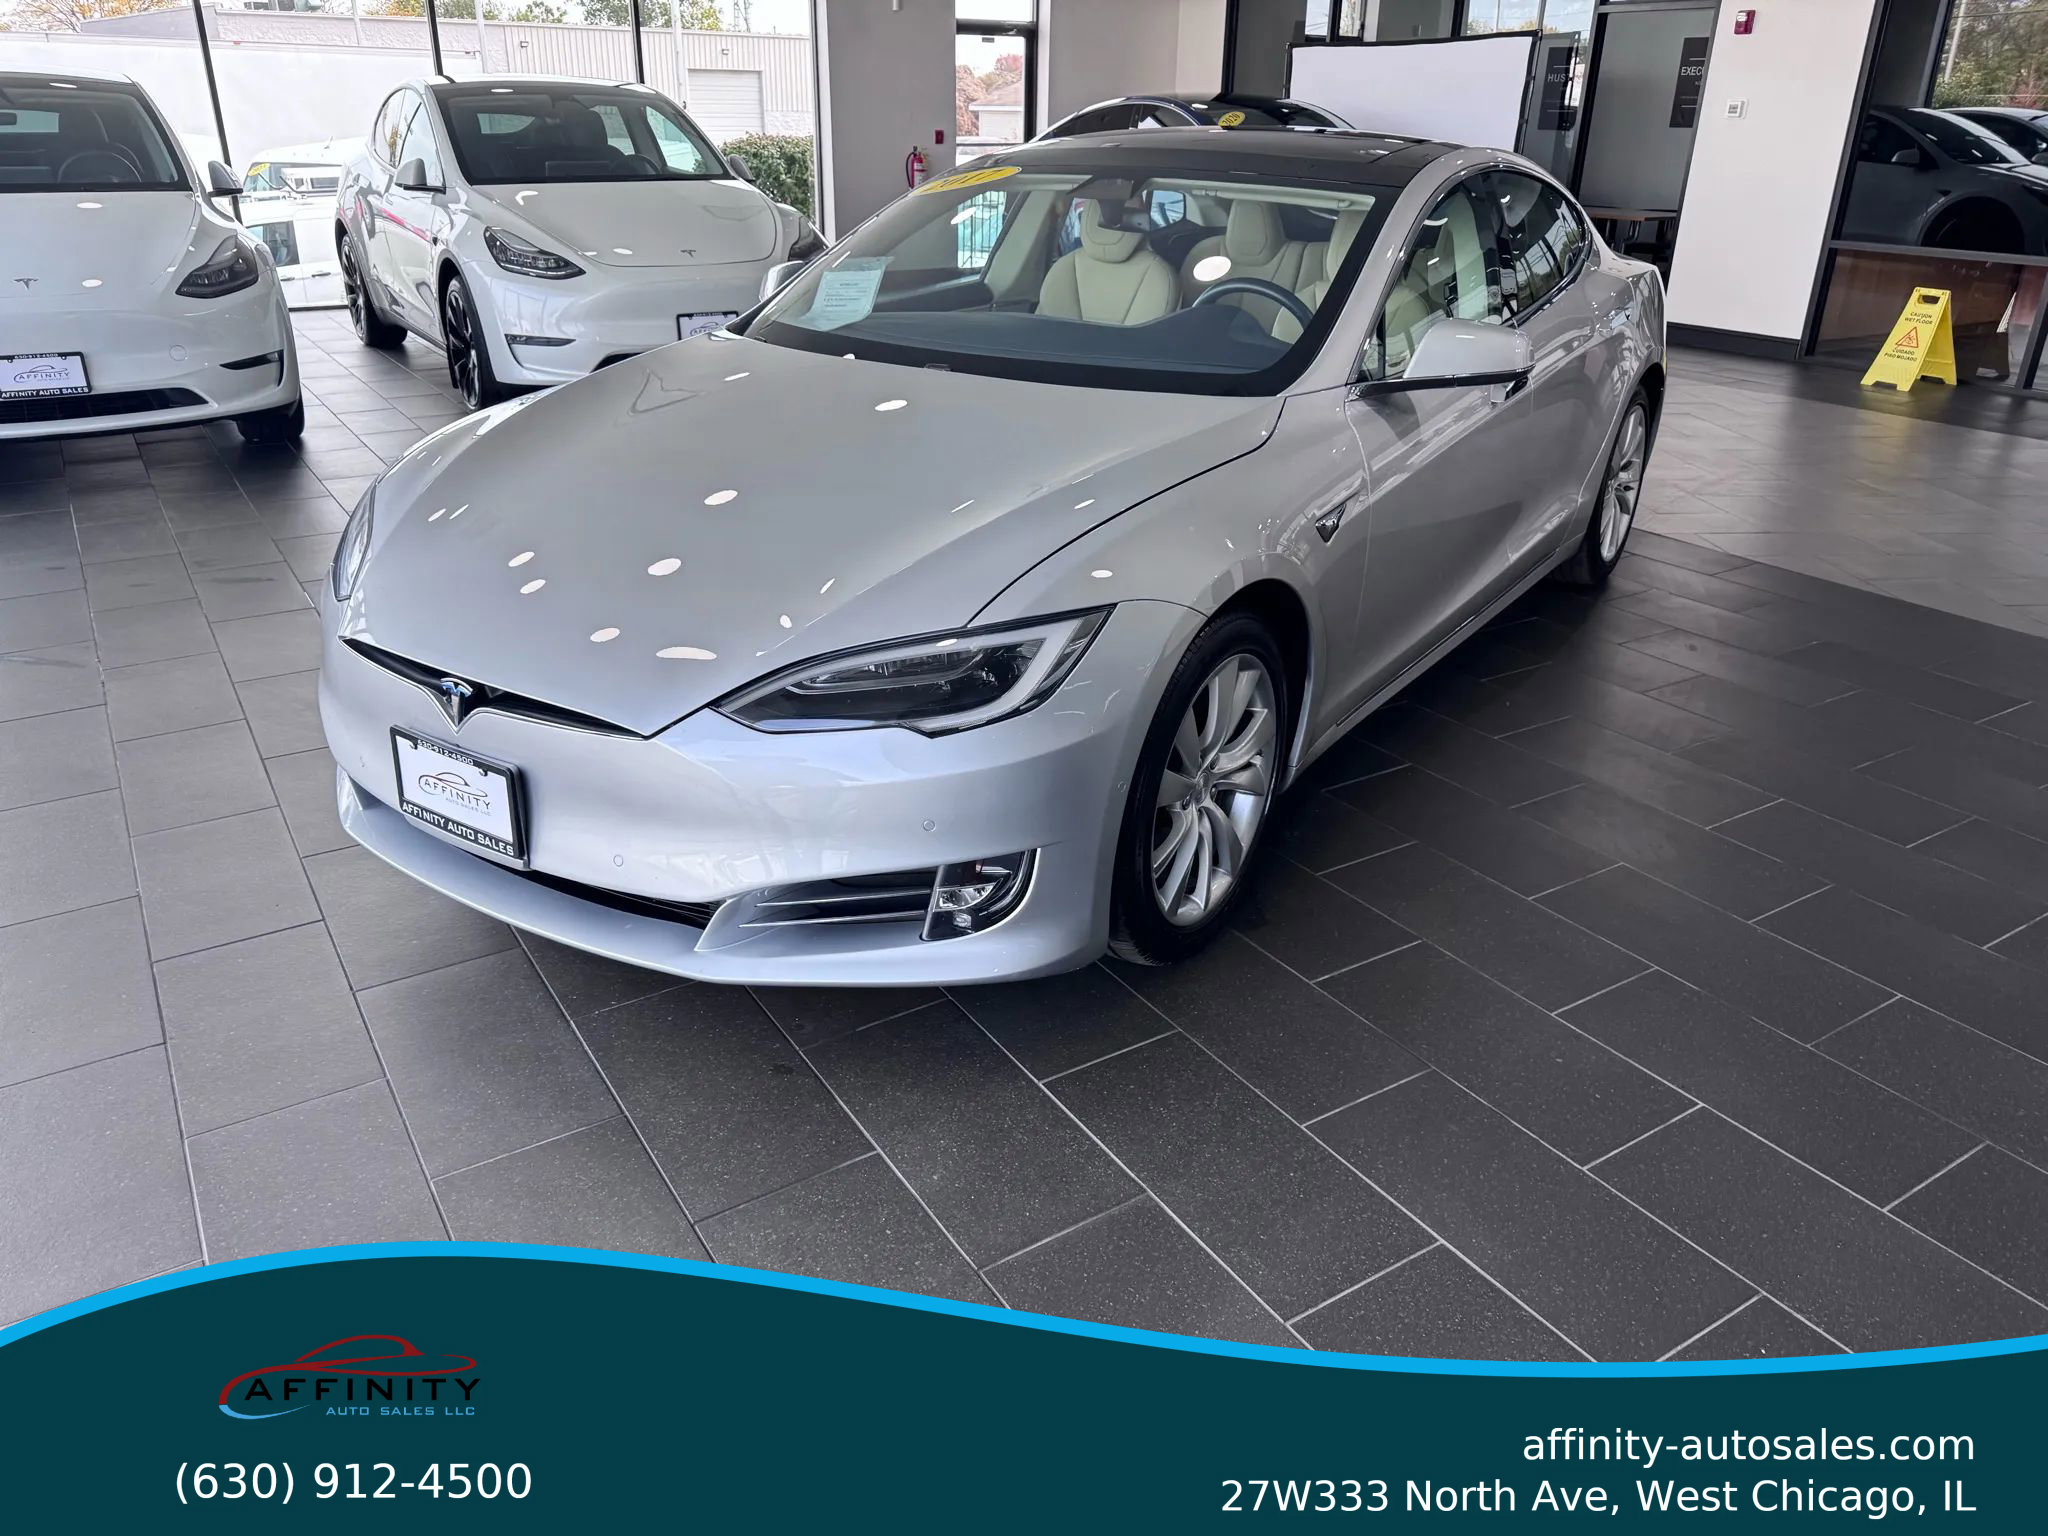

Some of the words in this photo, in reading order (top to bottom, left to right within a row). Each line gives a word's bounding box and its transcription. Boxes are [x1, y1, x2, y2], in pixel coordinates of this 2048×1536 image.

[19, 372, 70, 380] AFFINITY
[1, 390, 37, 398] AFFINITY
[39, 388, 61, 396] AUTO
[62, 386, 89, 394] SALES
[424, 778, 491, 810] AFFINITY
[402, 802, 446, 827] AFFINITY
[447, 821, 475, 840] AUTO
[477, 833, 515, 856] SALES
